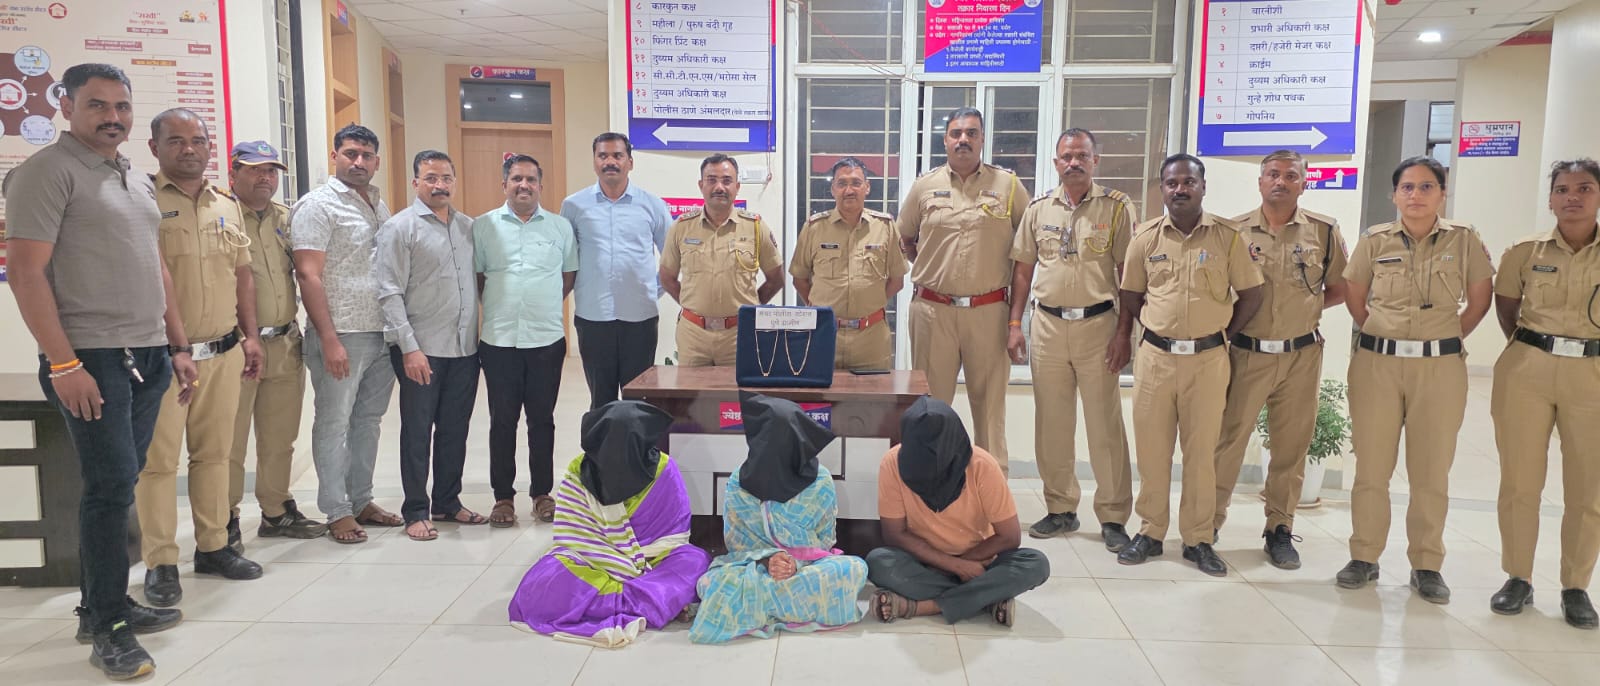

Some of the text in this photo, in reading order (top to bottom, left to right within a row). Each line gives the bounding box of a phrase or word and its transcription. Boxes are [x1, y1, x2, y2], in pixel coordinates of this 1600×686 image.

[652, 2, 678, 13] कारकुन
[687, 21, 703, 31] पुरुष
[706, 19, 720, 29] बंदी
[723, 22, 733, 32] गृह
[1250, 24, 1273, 33] प्रभारी
[1276, 23, 1310, 32] अधिकारी
[1314, 23, 1330, 32] कक्ष
[692, 38, 706, 46] कक्ष
[1294, 41, 1312, 50] मेजर
[1316, 41, 1331, 49] कक्ष
[653, 55, 673, 66] दुय्यम
[677, 53, 708, 64] अधिकारी
[711, 55, 726, 64] कक्ष
[1250, 58, 1271, 68] क्राईम
[742, 71, 756, 81] सेल
[1248, 76, 1269, 88] दुय्यम
[1272, 74, 1307, 84] अधिकारी
[1310, 75, 1326, 83] कक्ष
[654, 90, 674, 100] दुय्यम
[677, 88, 709, 98] अधिकारी
[712, 90, 726, 98] कक्ष
[1247, 92, 1261, 104] गुन्हे
[1264, 93, 1280, 102] शोध
[654, 104, 678, 114] पोलीस
[681, 105, 696, 115] ठाणे
[812, 412, 829, 422] कक्ष
